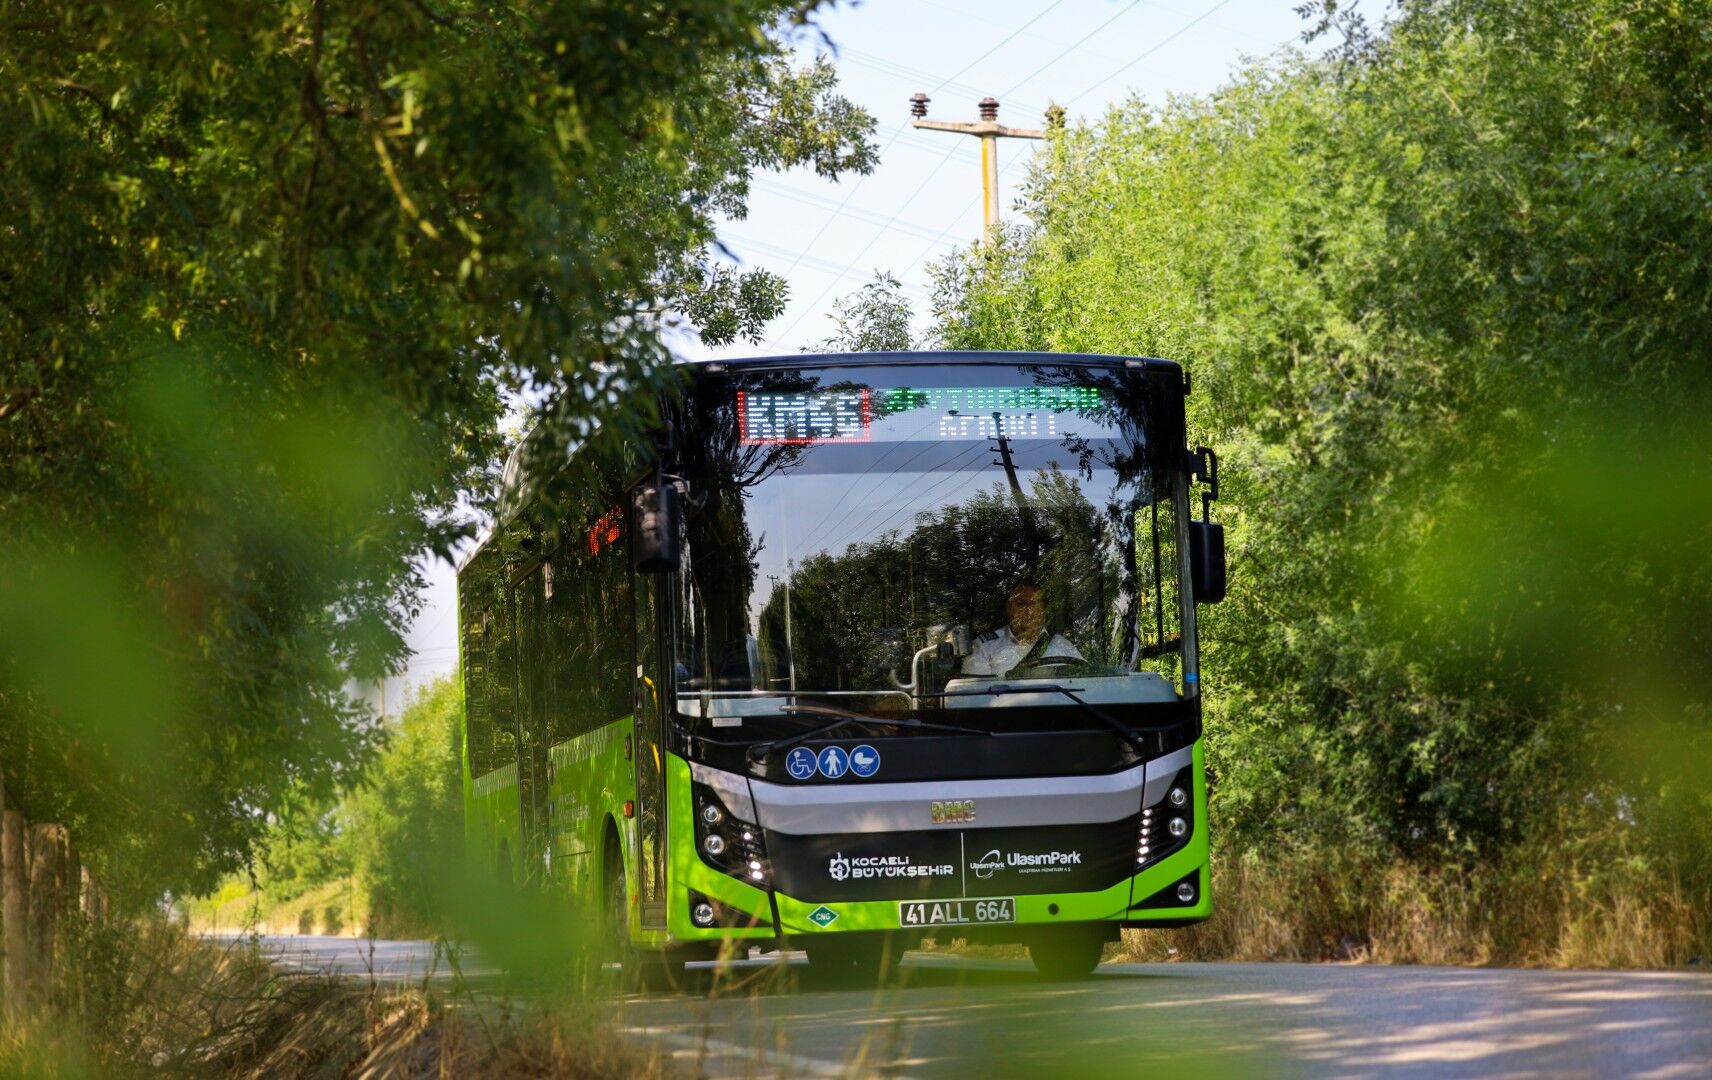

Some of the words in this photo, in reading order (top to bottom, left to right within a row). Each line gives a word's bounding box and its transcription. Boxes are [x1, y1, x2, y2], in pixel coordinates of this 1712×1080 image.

[931, 800, 976, 825] BMC
[851, 856, 909, 866] KOCAELİ
[852, 864, 954, 878] BÜYÜKŞEHİR
[906, 904, 925, 924] 41
[929, 903, 970, 924] ALL
[975, 901, 1011, 921] 664
